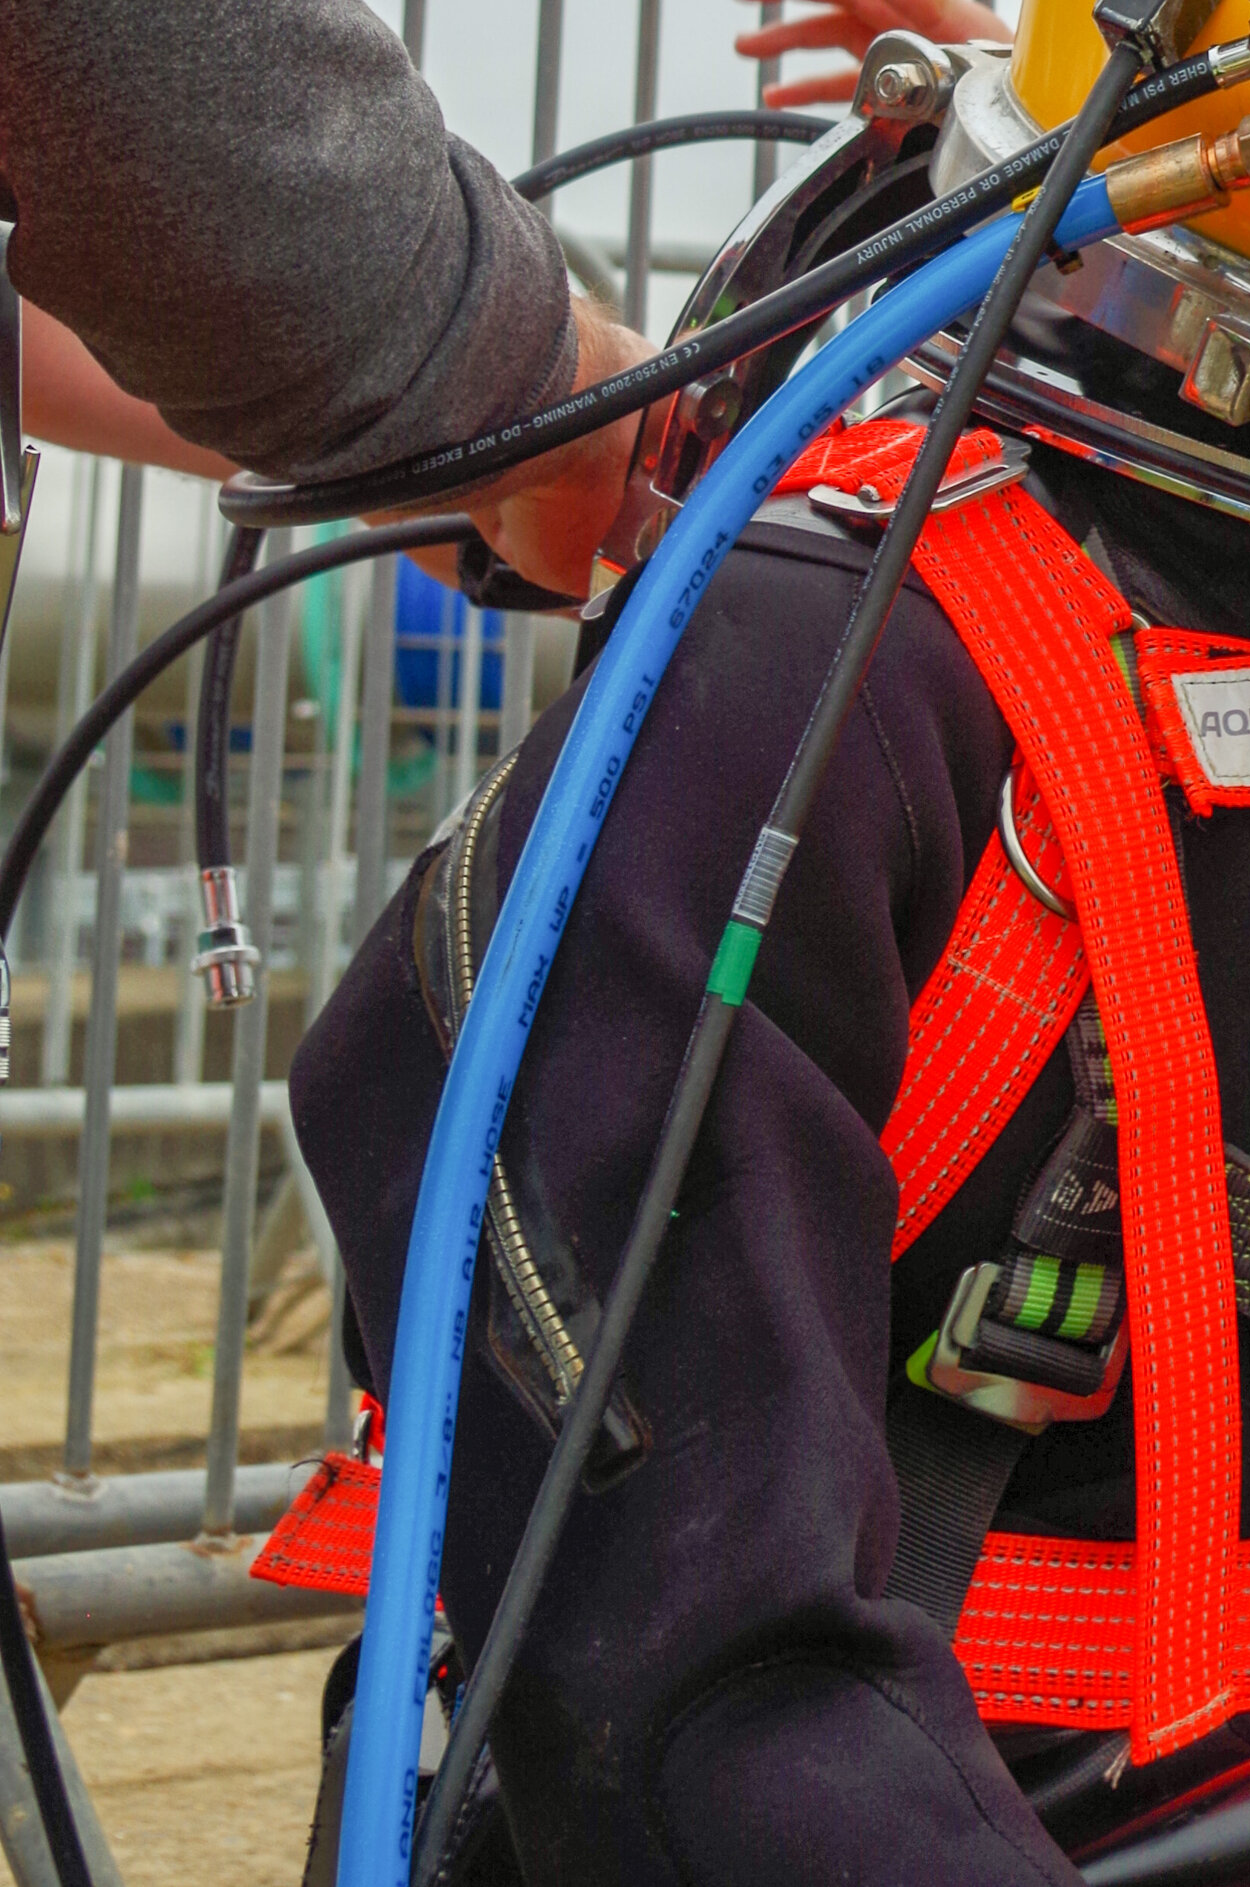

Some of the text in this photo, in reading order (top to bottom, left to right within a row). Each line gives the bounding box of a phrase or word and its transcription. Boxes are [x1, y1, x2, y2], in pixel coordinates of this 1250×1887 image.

[1169, 62, 1208, 88] GHER
[1143, 79, 1166, 100] PSI
[1002, 137, 1060, 178] DAMAGE
[978, 174, 1001, 192] OR
[905, 186, 977, 234] PERSONAL
[856, 231, 903, 265] INJURY
[657, 353, 679, 370] EN
[468, 434, 497, 455] NOT
[411, 447, 463, 474] EXCEED
[399, 1767, 416, 1861] AND
[452, 1310, 465, 1362] NB
[462, 1203, 482, 1281] AIR
[479, 1075, 513, 1176] HOSE
[518, 954, 549, 1027] MAX
[549, 885, 571, 933] WP
[589, 756, 621, 819] 500
[623, 674, 655, 735] PSI
[669, 529, 730, 630] 67024
